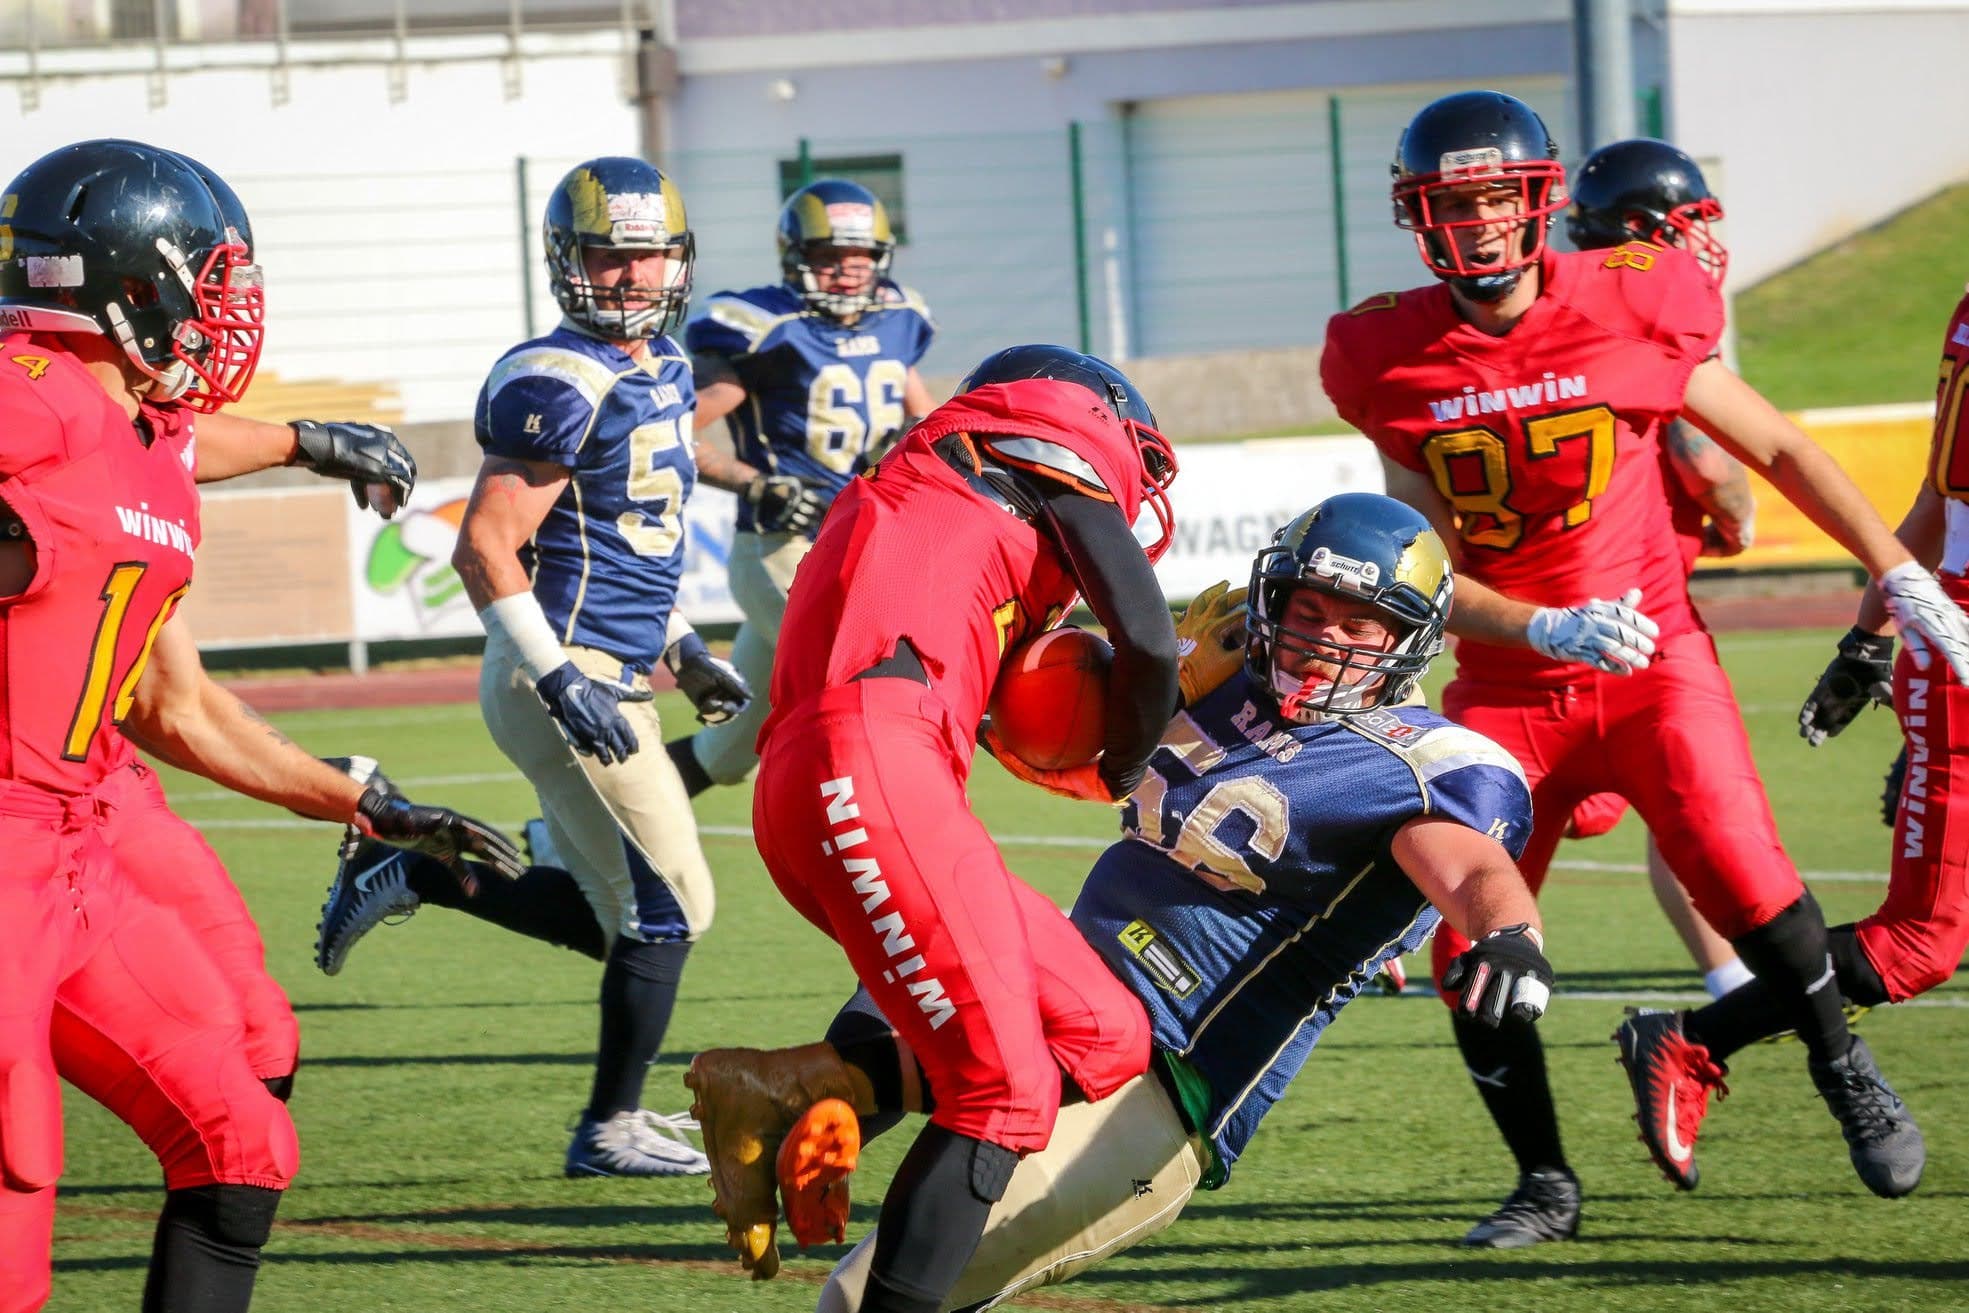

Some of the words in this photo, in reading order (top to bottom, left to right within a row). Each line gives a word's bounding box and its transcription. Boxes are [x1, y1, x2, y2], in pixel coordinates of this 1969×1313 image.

[616, 411, 698, 557] 5
[1421, 402, 1616, 552] 87
[1230, 699, 1302, 763] RAMS
